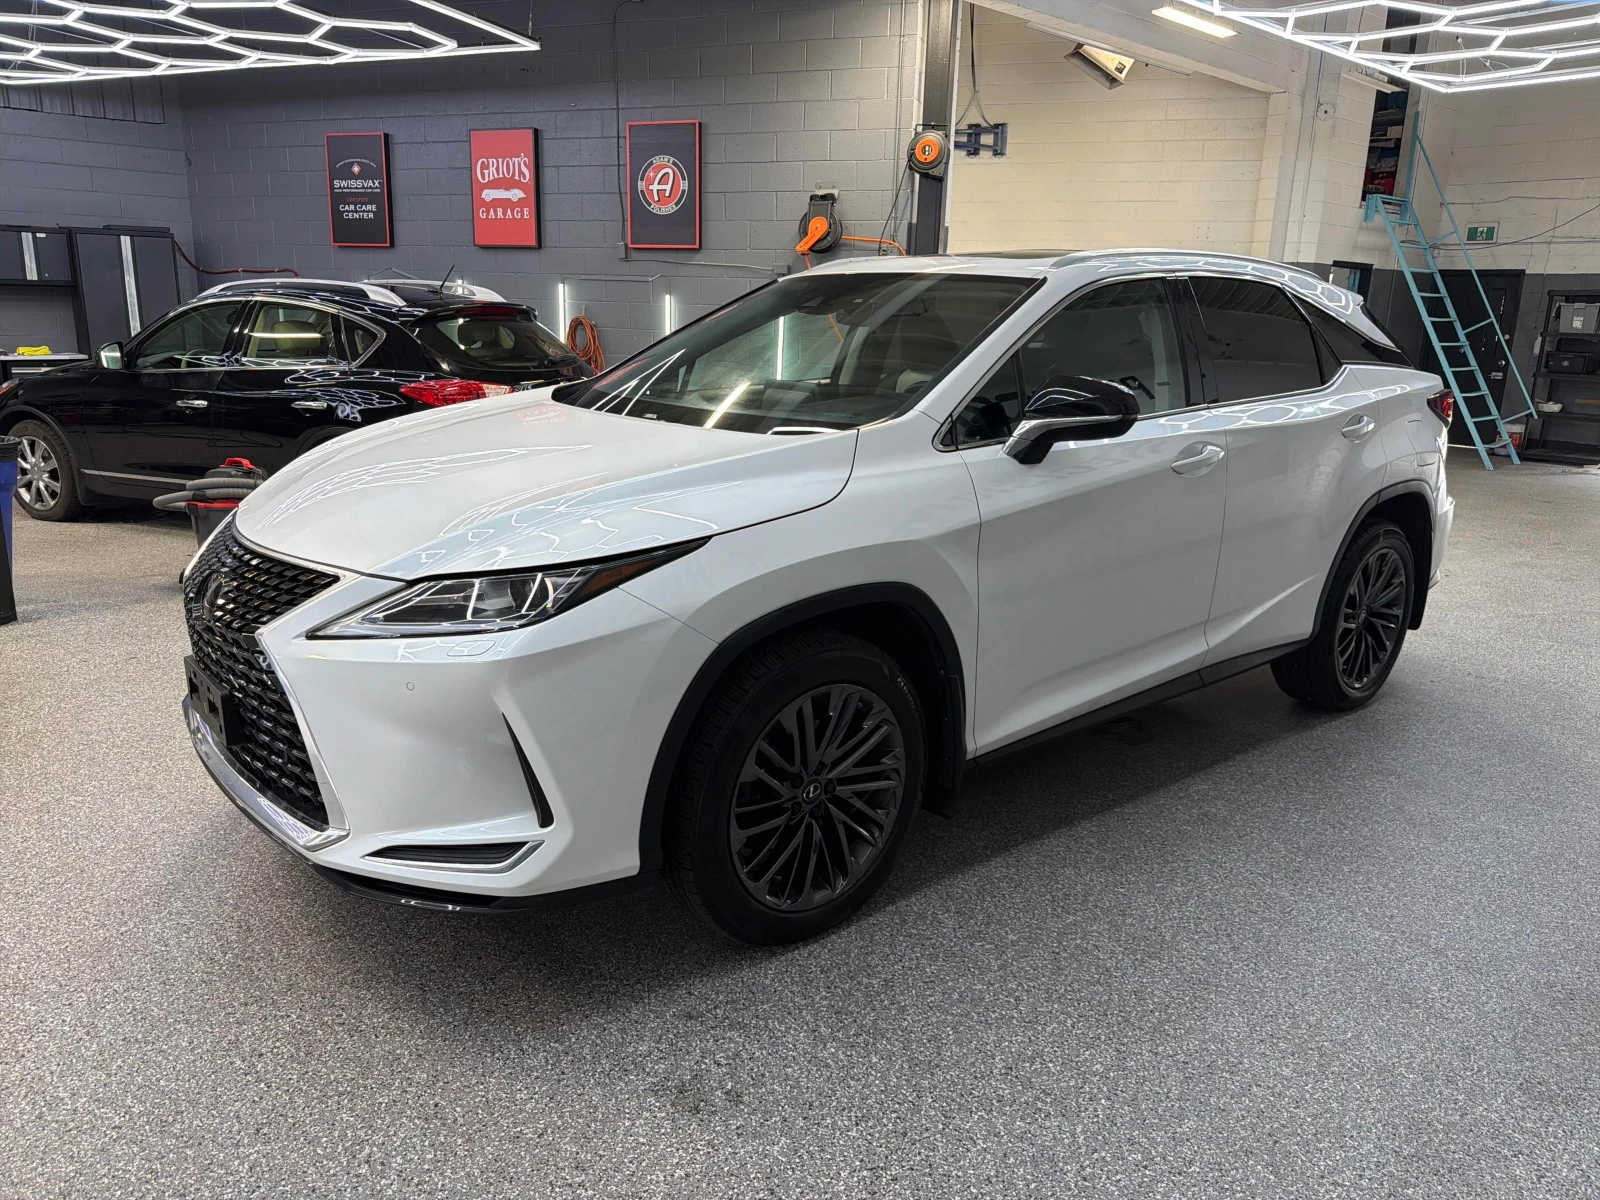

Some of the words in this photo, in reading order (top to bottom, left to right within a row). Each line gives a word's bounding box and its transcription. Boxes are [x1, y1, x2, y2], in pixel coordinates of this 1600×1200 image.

[476, 152, 530, 183] GRIOT'S
[333, 180, 380, 188] SWISSVAX
[479, 207, 530, 219] GARAGE
